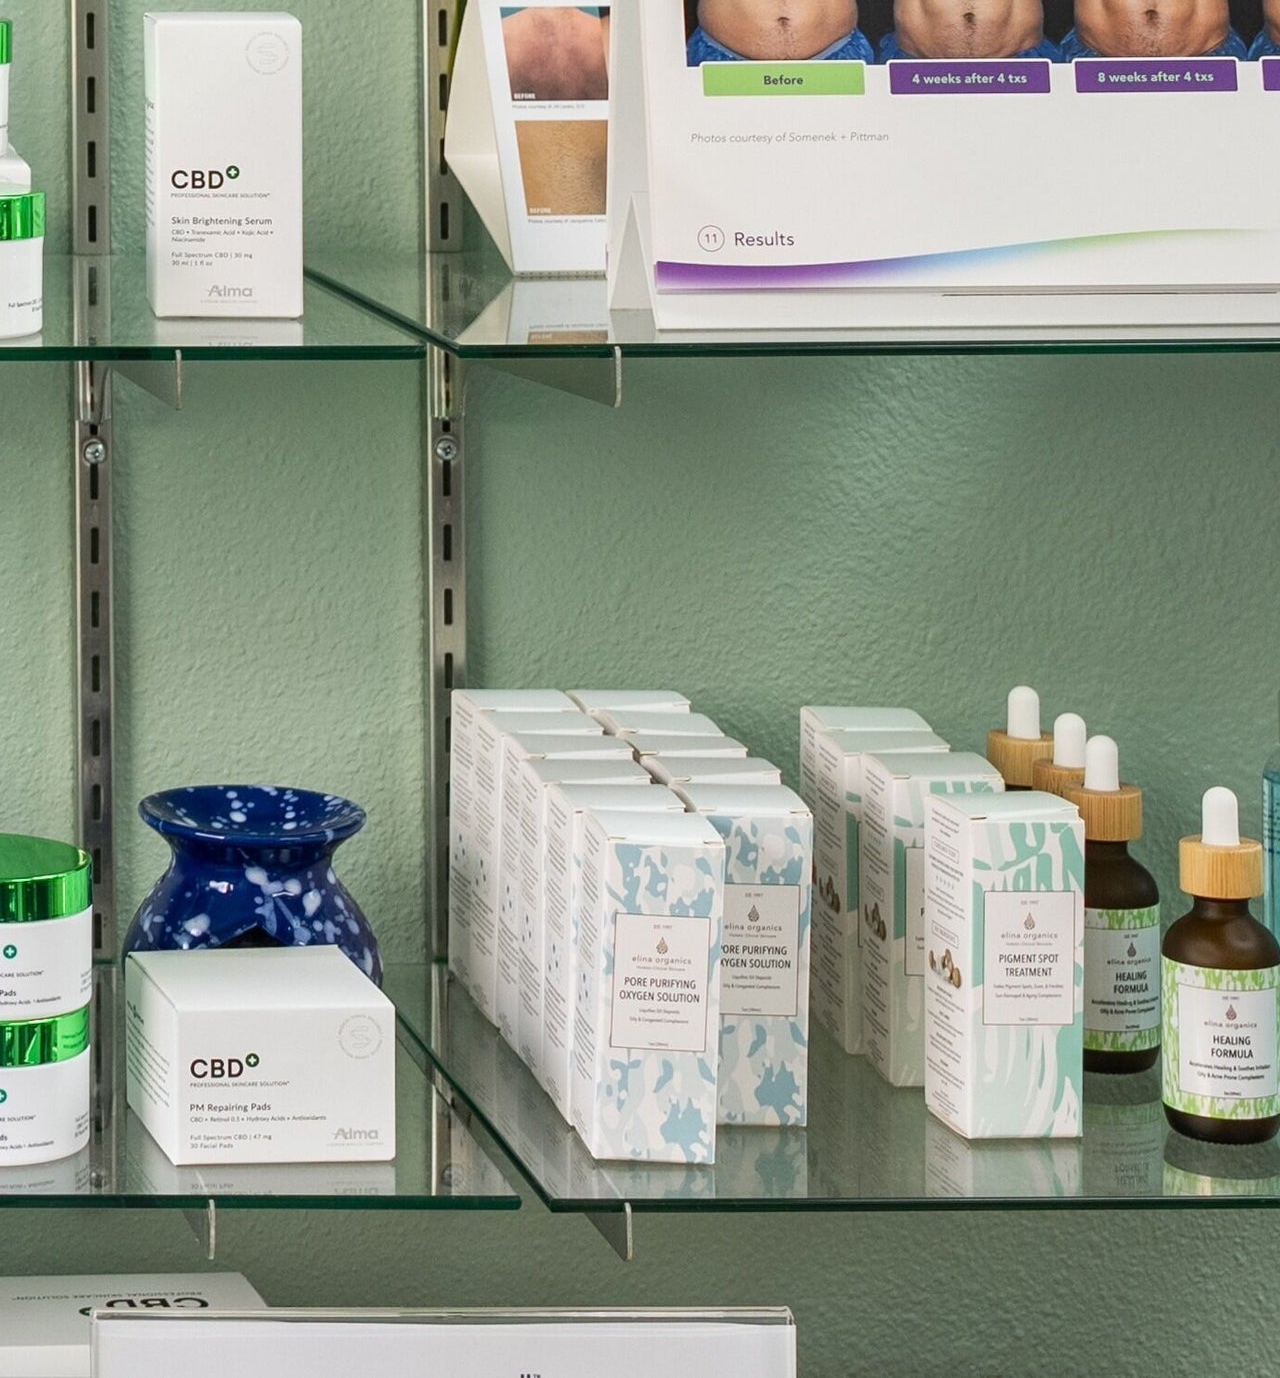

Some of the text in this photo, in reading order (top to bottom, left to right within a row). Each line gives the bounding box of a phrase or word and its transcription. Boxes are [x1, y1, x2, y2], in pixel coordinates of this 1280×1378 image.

[763, 74, 803, 86] Before
[912, 72, 1028, 84] 4 weeks after 4 txs
[1098, 71, 1214, 83] 8 weeks after 4 txs
[691, 132, 889, 145] Photos courtesy of Somenek Pittman
[171, 170, 224, 189] CBD
[171, 217, 273, 227] Skin Brightening Serum
[704, 231, 795, 247] 11 Results
[999, 953, 1059, 964] PIGMENT SPOT
[1005, 967, 1052, 977] TREATMENT
[1115, 972, 1147, 983] HEALING
[624, 977, 696, 989] PORE PURIFYING
[1113, 984, 1148, 994] FORMULA
[619, 991, 699, 1003] OXYGEN SOLUTION
[1213, 1035, 1250, 1046] HEALING
[1211, 1049, 1253, 1059] FORMULA
[191, 1058, 243, 1078] CBD
